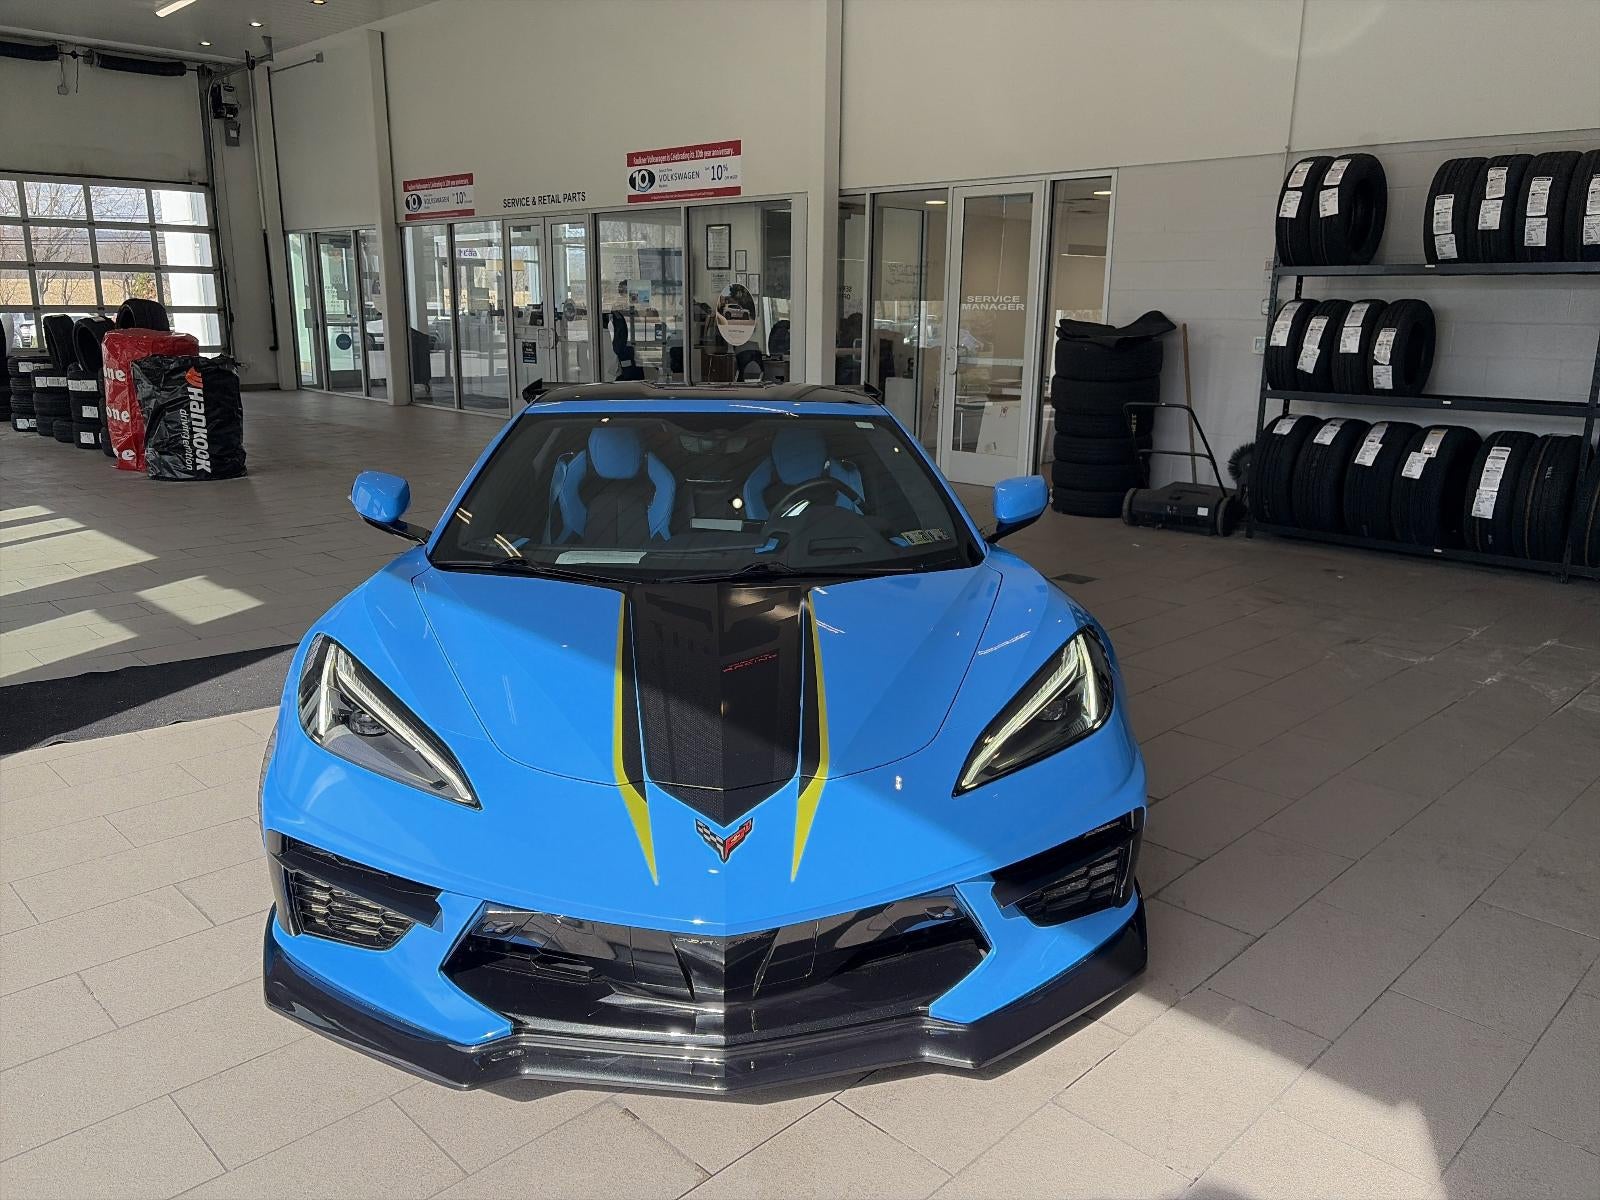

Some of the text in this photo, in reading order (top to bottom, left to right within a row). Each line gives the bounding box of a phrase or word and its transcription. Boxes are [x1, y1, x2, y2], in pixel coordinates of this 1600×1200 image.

[633, 170, 649, 191] 10
[659, 171, 700, 182] VOLKSWAGEN
[502, 191, 586, 208] SERVICE & RETAIL PARTS
[961, 303, 1025, 311] MANAGER
[967, 295, 1020, 303] SERVICE
[179, 409, 191, 439] driving
[187, 387, 212, 473] Hankook
